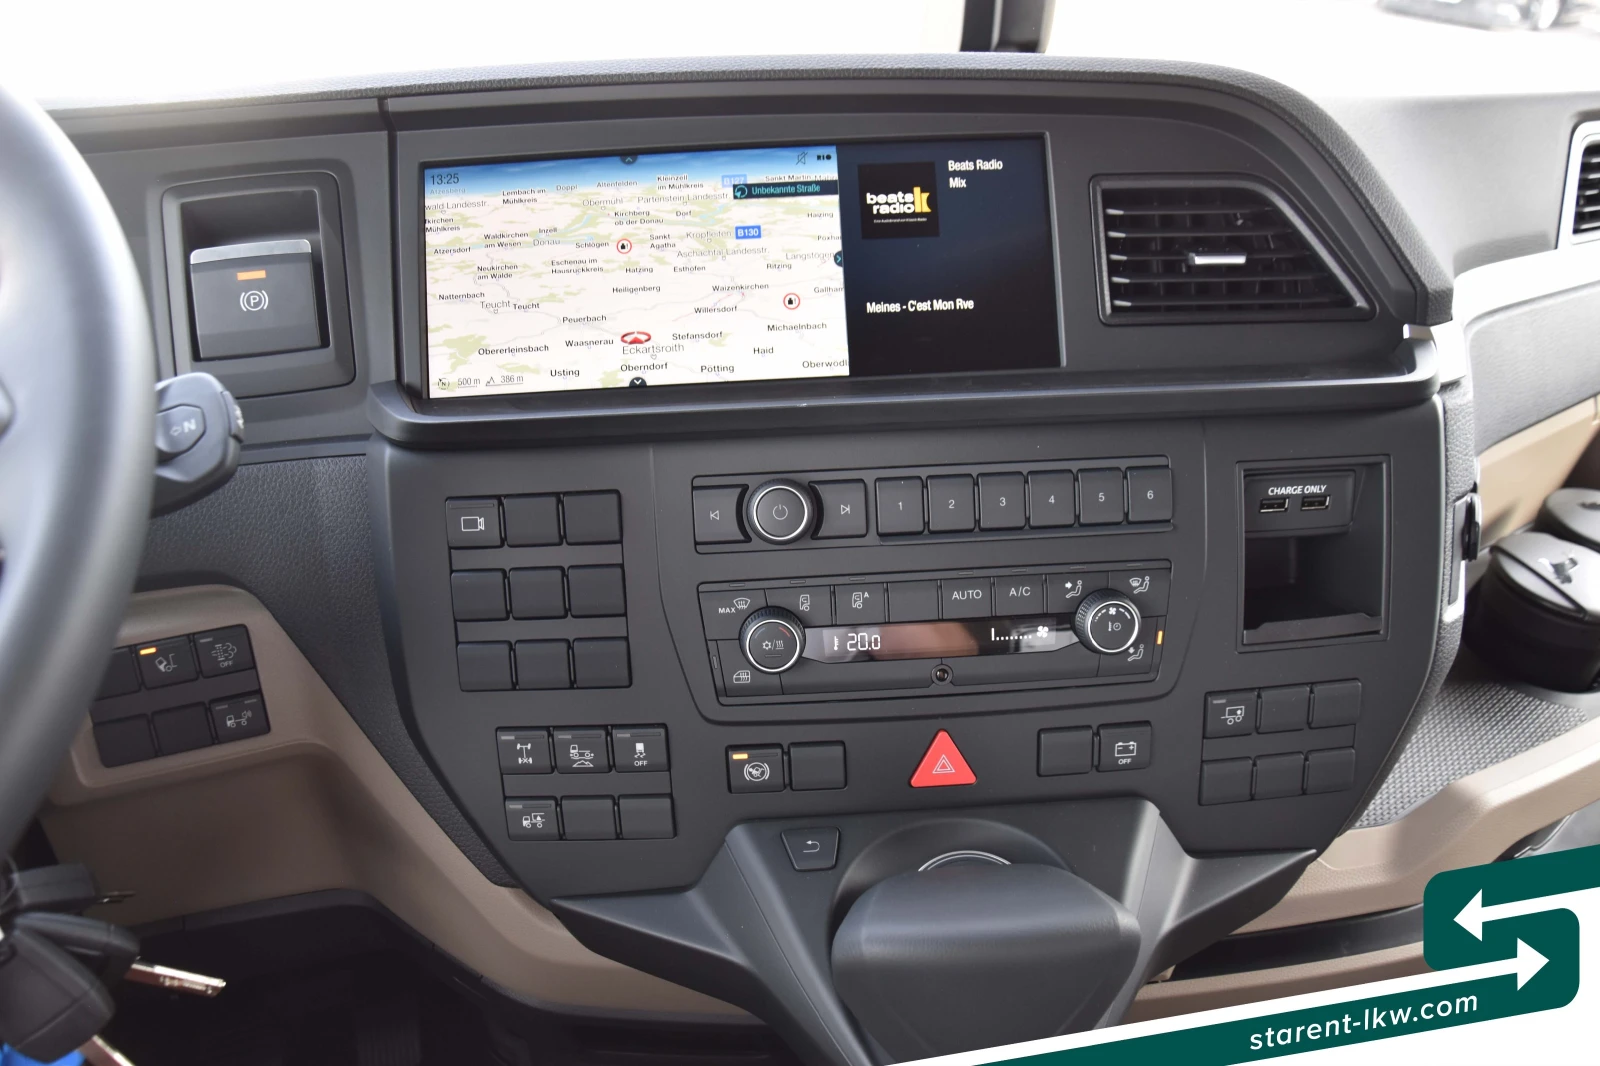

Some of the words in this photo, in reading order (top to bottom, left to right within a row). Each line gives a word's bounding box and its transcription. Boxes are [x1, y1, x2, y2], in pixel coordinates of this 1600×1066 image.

[948, 159, 975, 171] Beats
[976, 158, 1003, 171] Radio
[430, 173, 460, 186] 13:25
[657, 174, 688, 182] Kleinzell
[949, 177, 967, 188] Mix
[556, 184, 578, 192] Doppl
[596, 180, 638, 188] Altenfelden
[751, 184, 796, 195] Unbekannte
[796, 182, 821, 194] Straße
[502, 189, 536, 197] Lembach
[637, 194, 685, 204] Partenstein
[687, 192, 730, 201] Landesstr.
[866, 191, 914, 204] beats
[446, 200, 490, 210] Landesstr.
[872, 202, 915, 215] radio
[614, 210, 650, 219] Kirchberg
[484, 232, 529, 240] Waldkirchen
[737, 228, 759, 237] B130
[497, 240, 522, 248] Wesen
[532, 238, 561, 247] Donau
[650, 242, 676, 250] Agatha
[433, 246, 471, 255] Atzersdorf
[725, 246, 770, 256] Landesstr.
[477, 264, 519, 272] Neukirchen
[625, 266, 654, 274] Hatzing
[673, 265, 706, 273] Esthofen
[766, 263, 792, 271] Ritzing
[490, 272, 513, 280] Walde
[612, 284, 661, 294] Heiligenberg
[712, 283, 770, 292] Waizenkirchen
[249, 295, 260, 307] P
[438, 291, 485, 301] Natternbach
[480, 300, 511, 310] Teucht
[512, 302, 540, 311] Teucht
[694, 305, 738, 314] Willersdorf
[866, 301, 901, 313] Meines
[907, 300, 932, 312] C'est
[933, 299, 955, 311] Mon
[956, 298, 974, 310] Rve
[562, 314, 607, 325] Peuerbach
[767, 322, 828, 332] Michaelnbach
[672, 331, 723, 341] Stefansdorf
[565, 338, 614, 348] Waasnerau
[478, 344, 550, 356] Obererleinsbach
[622, 343, 685, 355] Eckartsroith
[753, 346, 774, 355] Haid
[620, 362, 668, 372] Oberndorf
[700, 365, 735, 374] Pötting
[500, 374, 515, 383] 386
[516, 374, 524, 382] m
[550, 368, 580, 379] Usting
[457, 377, 472, 386] 500
[473, 377, 481, 385] m
[183, 418, 196, 433] N
[1146, 490, 1153, 500] 6
[1268, 485, 1304, 496] CHARGE
[1303, 484, 1327, 494] ONLY
[999, 497, 1006, 507] 3
[1049, 495, 1055, 505] 4
[1098, 492, 1105, 502] 5
[898, 501, 903, 511] 1
[948, 499, 956, 509] 2
[952, 590, 982, 601] AUTO
[1009, 586, 1031, 597] A/C
[718, 606, 736, 614] MAX
[847, 633, 881, 651] 20.0
